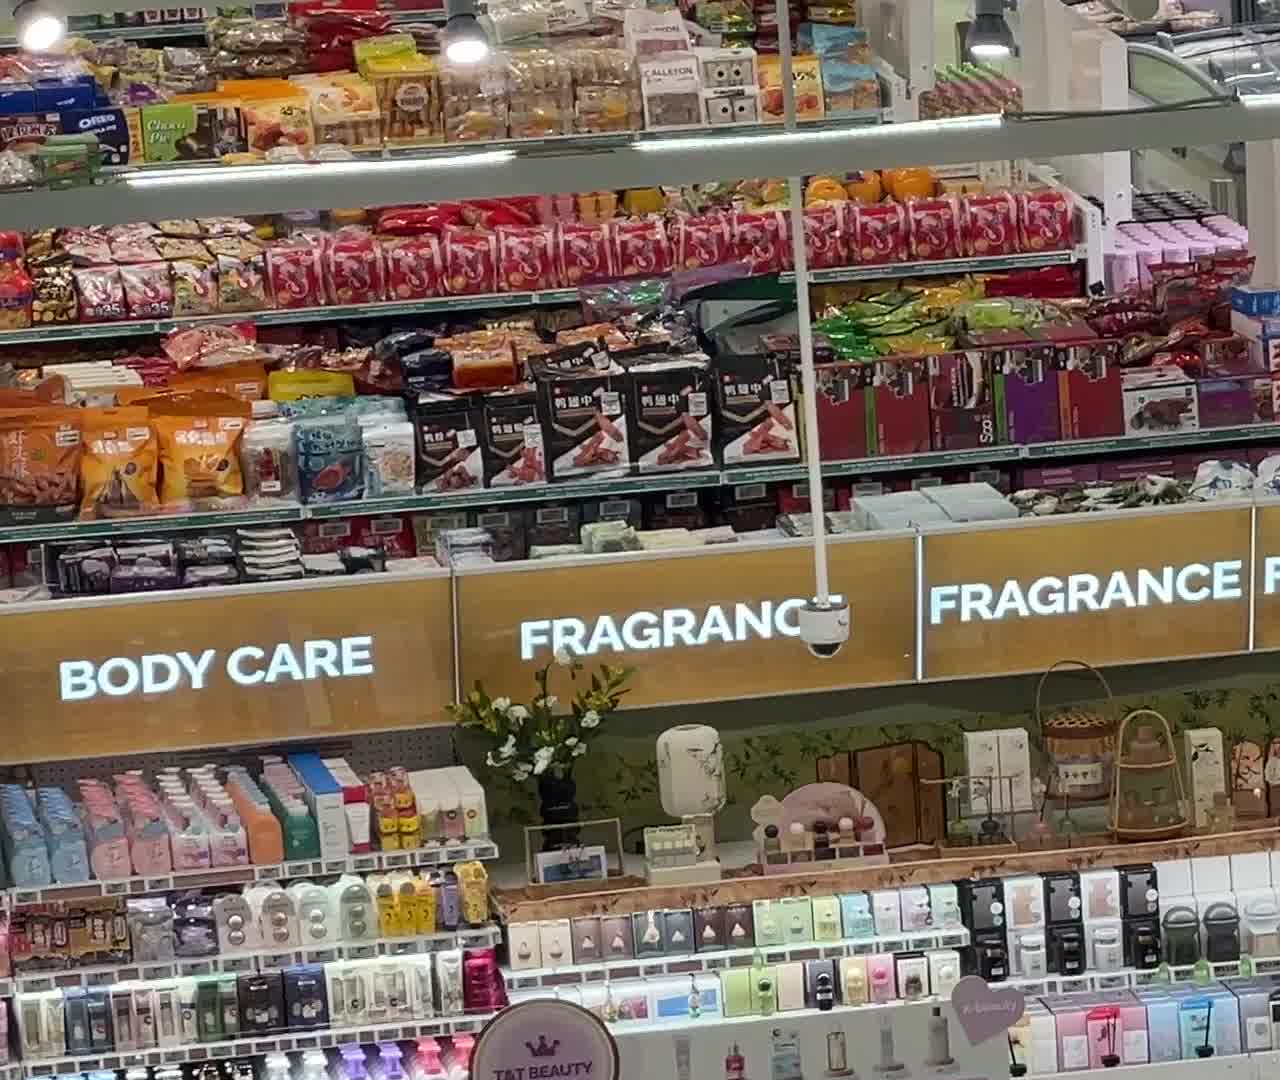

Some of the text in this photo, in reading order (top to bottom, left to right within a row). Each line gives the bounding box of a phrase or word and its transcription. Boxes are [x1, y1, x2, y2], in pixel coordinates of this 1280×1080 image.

[147, 119, 186, 132] Choco
[929, 559, 1243, 625] FRAGRANCE
[60, 634, 374, 702] BODY CARE
[528, 1059, 594, 1080] BEAUTY
